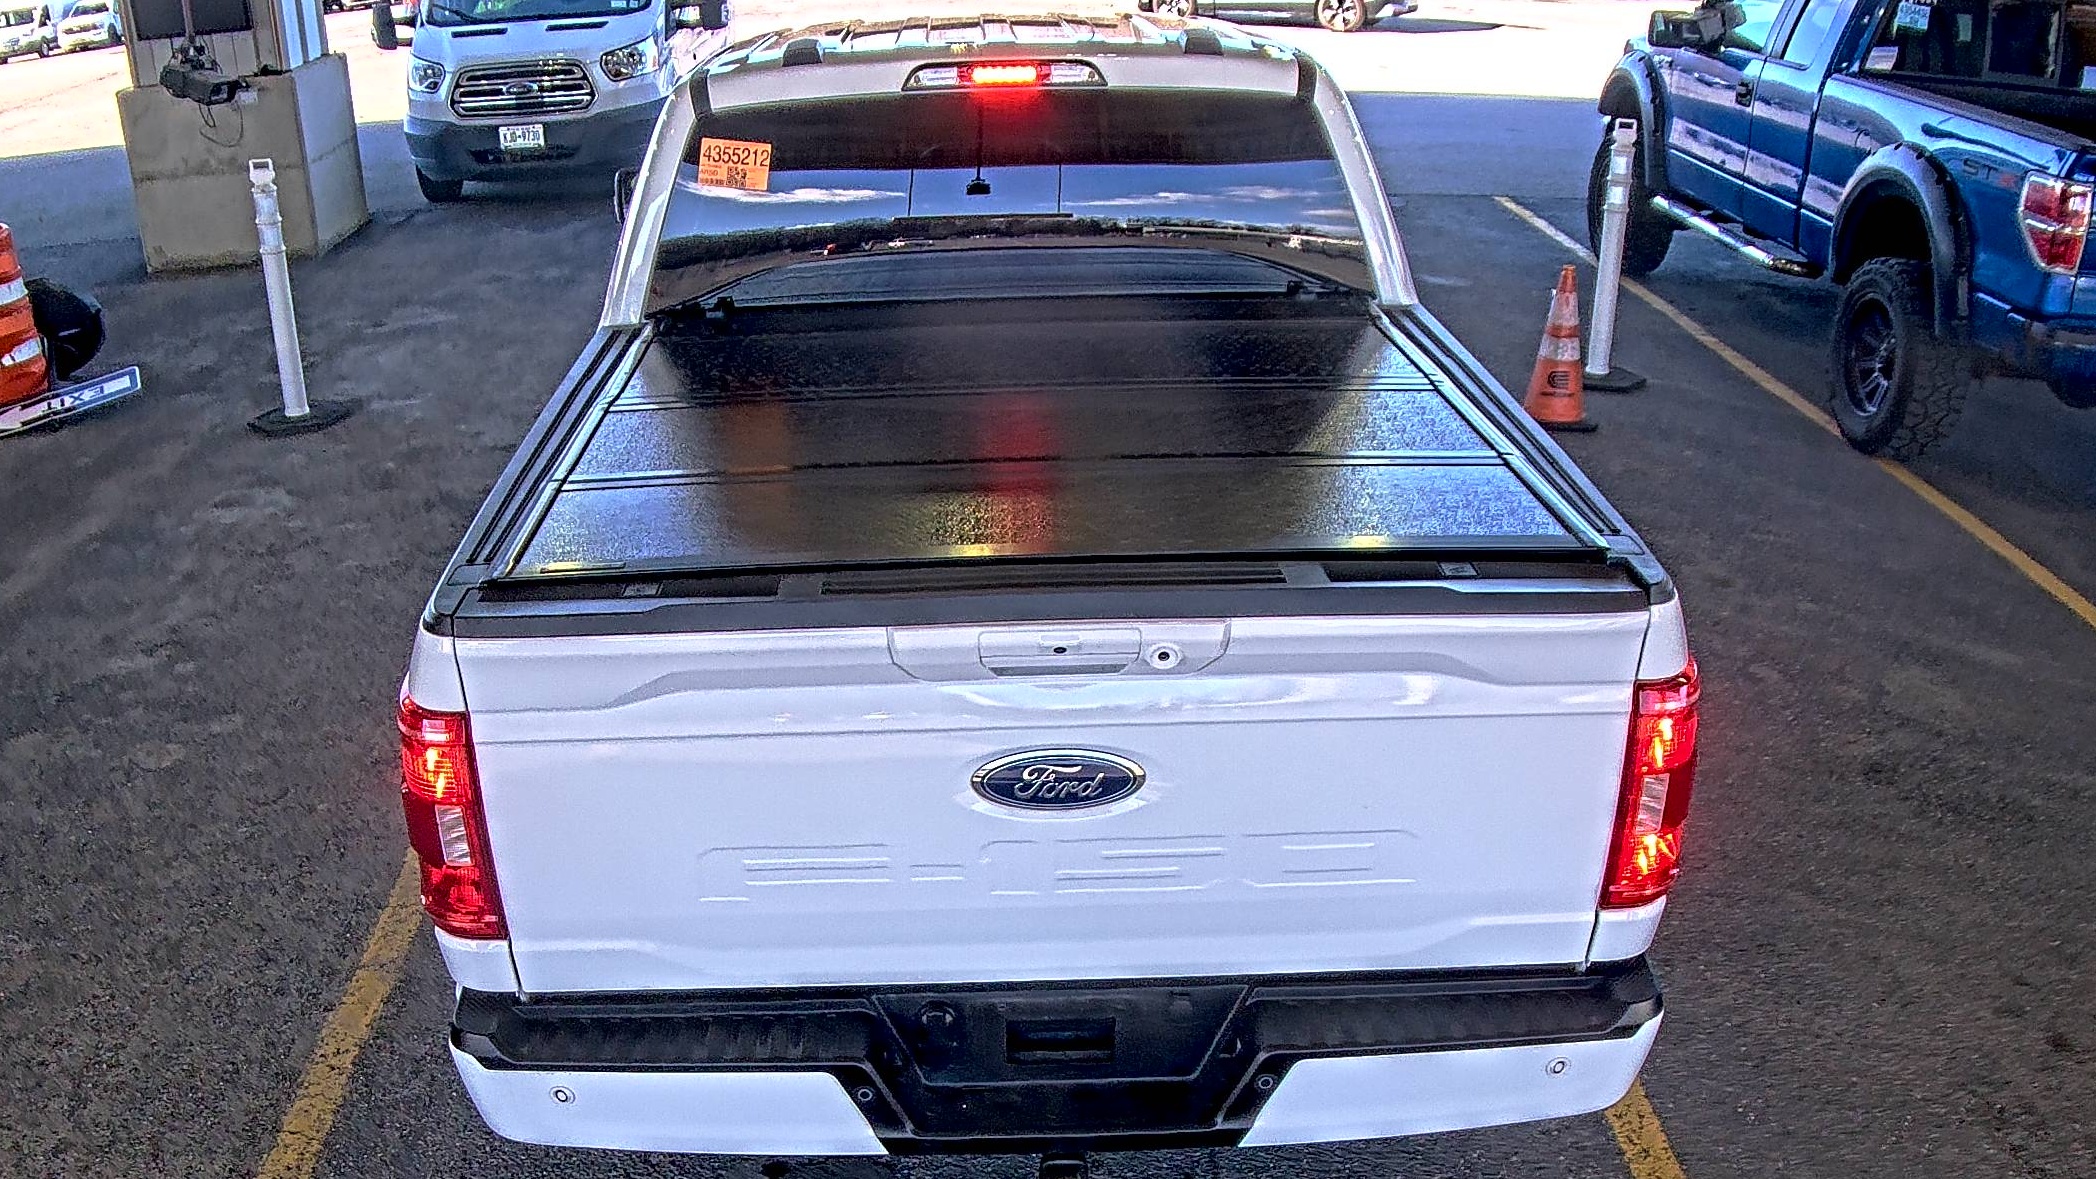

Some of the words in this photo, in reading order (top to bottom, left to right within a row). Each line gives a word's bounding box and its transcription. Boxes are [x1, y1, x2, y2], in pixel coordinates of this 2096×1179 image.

[703, 144, 769, 167] 4355212
[41, 385, 104, 412] EXIT
[1014, 764, 1105, 799] Ford
